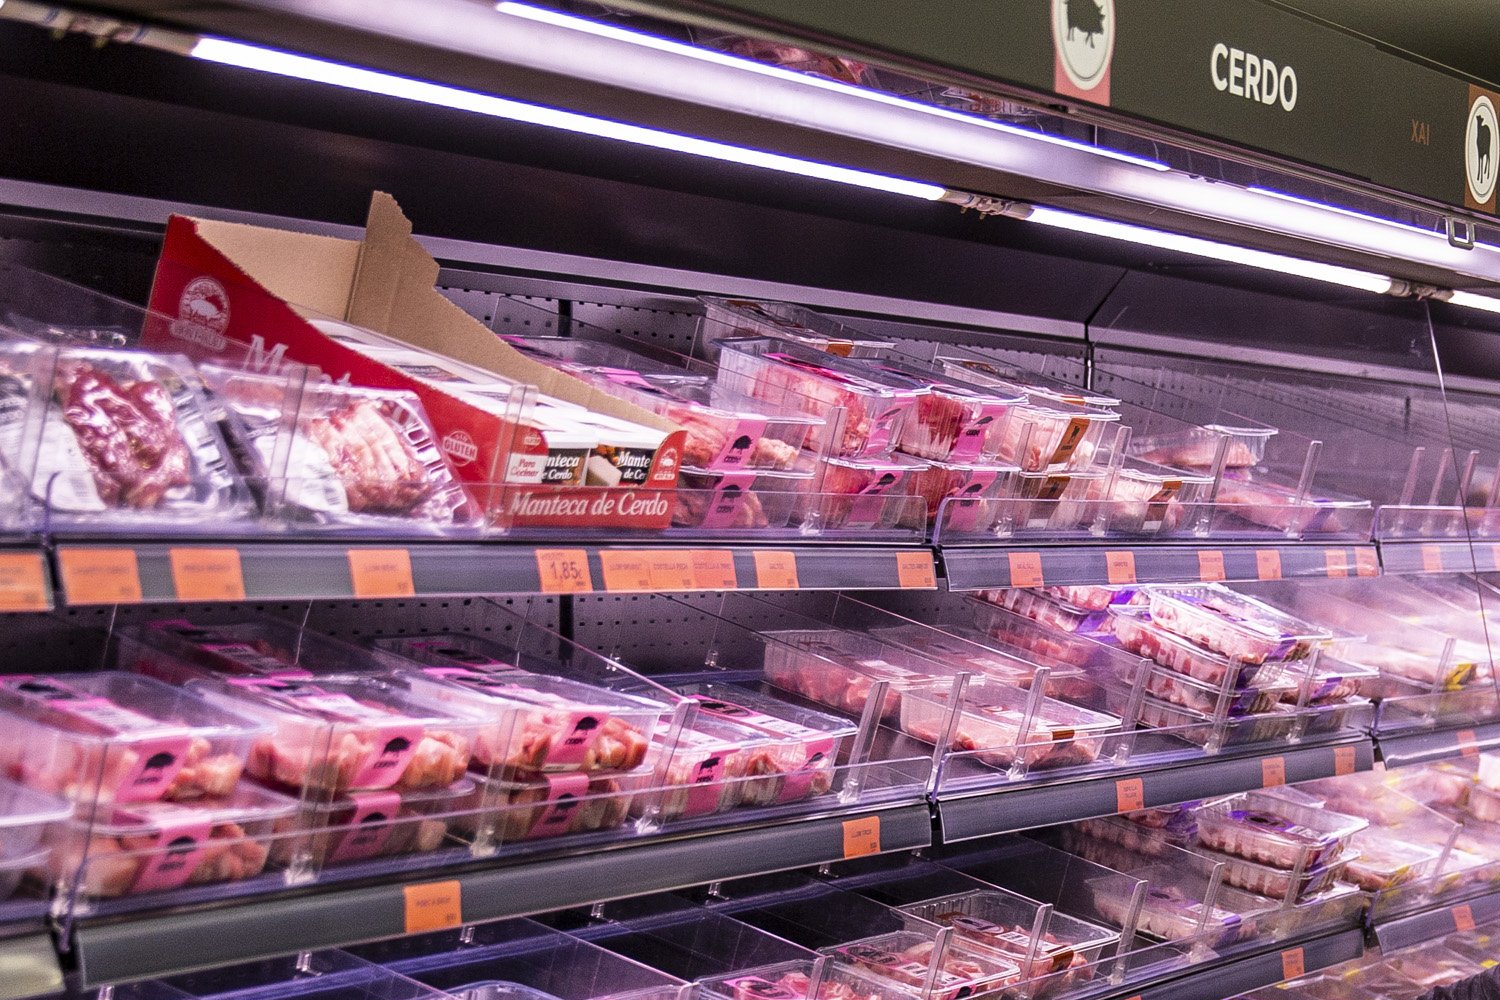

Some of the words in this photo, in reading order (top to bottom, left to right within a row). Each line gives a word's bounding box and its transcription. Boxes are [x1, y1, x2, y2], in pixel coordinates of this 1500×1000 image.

[1211, 43, 1298, 112] CERDO
[1411, 119, 1430, 146] XAI
[444, 439, 477, 459] GLUTEN
[509, 492, 587, 516] Manteca
[590, 492, 614, 516] de
[616, 491, 669, 516] Cerdo
